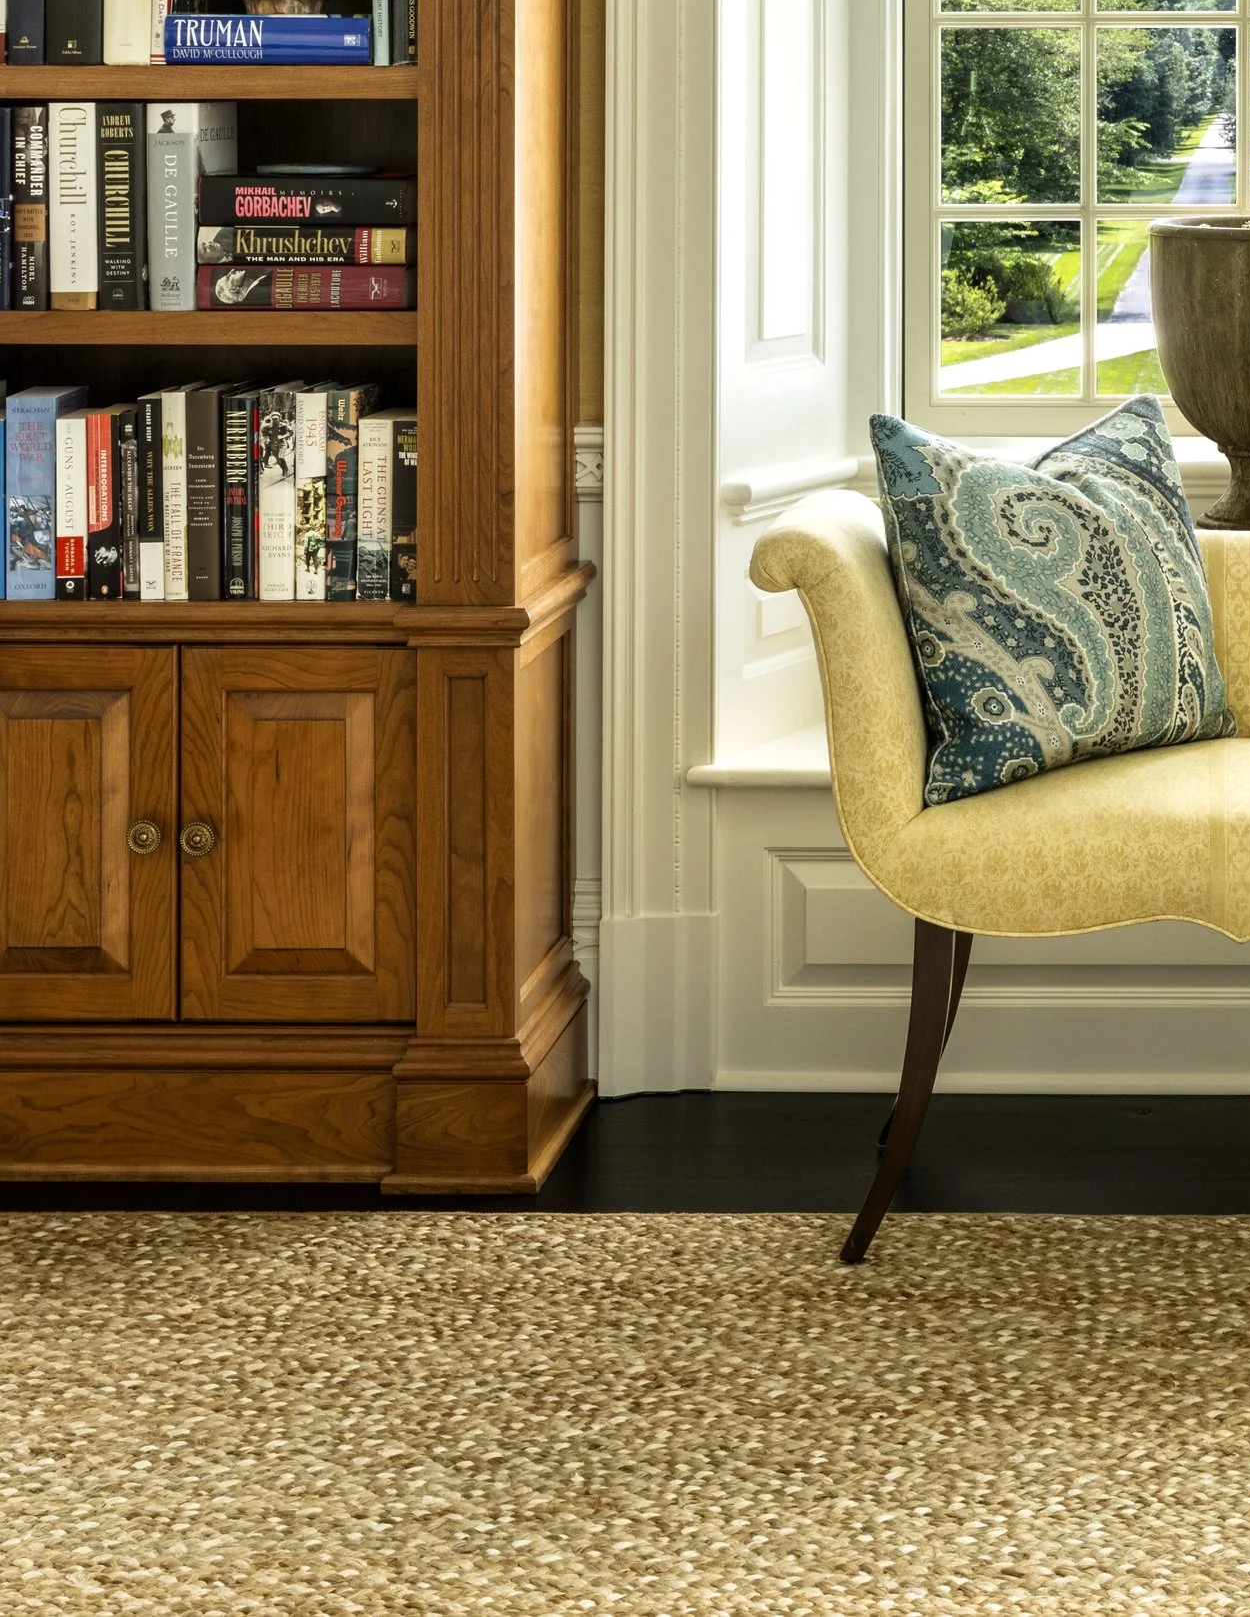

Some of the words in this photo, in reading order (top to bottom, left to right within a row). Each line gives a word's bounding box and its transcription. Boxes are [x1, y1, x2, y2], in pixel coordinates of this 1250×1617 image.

[173, 19, 264, 47] TRUMAN
[172, 48, 200, 59] DAVID
[203, 48, 263, 59] McCULLOUGH
[100, 127, 134, 138] ROBERTS
[102, 115, 131, 126] ANDREW
[15, 136, 25, 149] IN
[15, 152, 26, 185] CHIEF
[30, 125, 43, 197] COMMANDER
[164, 153, 177, 178] DE
[104, 149, 130, 248] CHURCHILL
[235, 187, 277, 195] MIKHAIL
[235, 196, 312, 217] GORBACHEV
[164, 184, 178, 259] GAULLE
[235, 229, 353, 255] Khrushchev
[359, 230, 369, 264] William
[330, 269, 342, 308] LACOUTURE
[337, 399, 346, 421] Weitz
[15, 433, 45, 441] FIRST
[19, 422, 44, 431] THE
[305, 418, 318, 448] 1945
[10, 442, 53, 452] WORLD
[19, 453, 44, 462] WAR
[63, 437, 73, 470] GUNS
[226, 410, 248, 484] NUREMBERG
[100, 449, 108, 523] INTERROGATIONS
[362, 461, 373, 493] LAST
[64, 484, 75, 531] AUGUST
[362, 498, 373, 539] LIGHT
[14, 583, 47, 591] OXFORD
